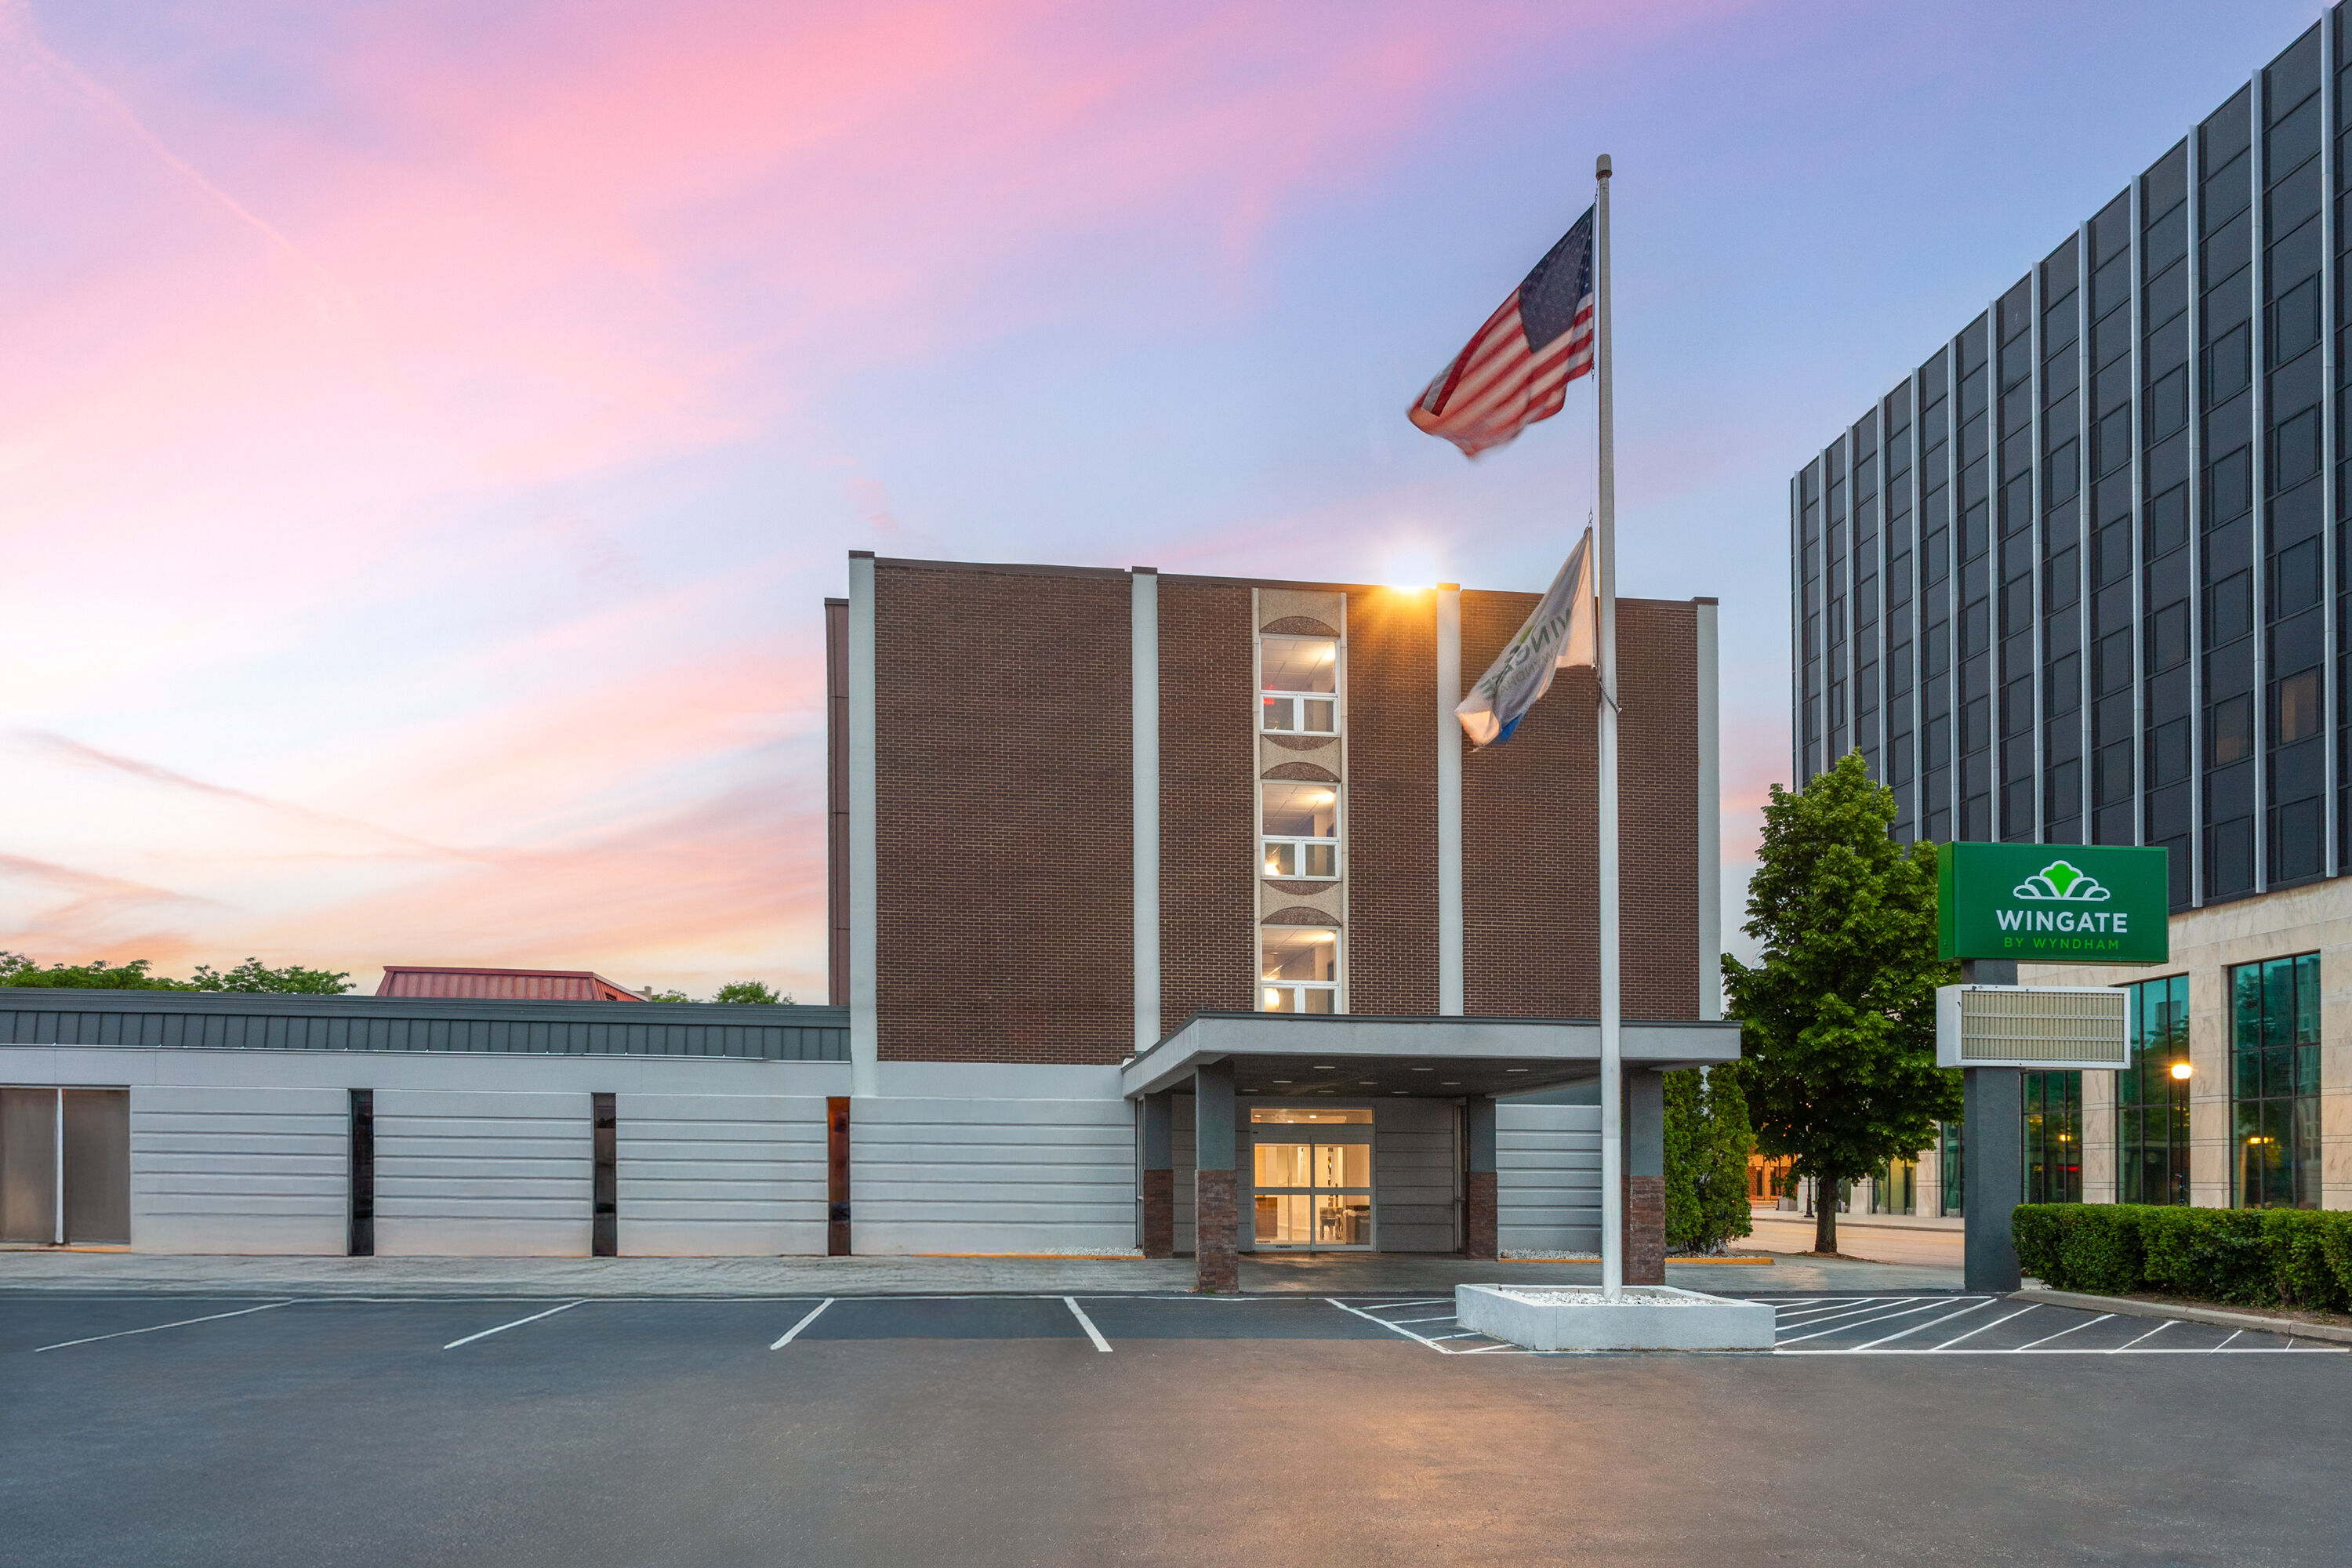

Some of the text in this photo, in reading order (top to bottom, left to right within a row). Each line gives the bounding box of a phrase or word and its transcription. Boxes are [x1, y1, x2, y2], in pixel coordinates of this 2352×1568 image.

[1995, 909, 2128, 933] WINGATE
[2004, 937, 2118, 950] BY WYNDHAM
